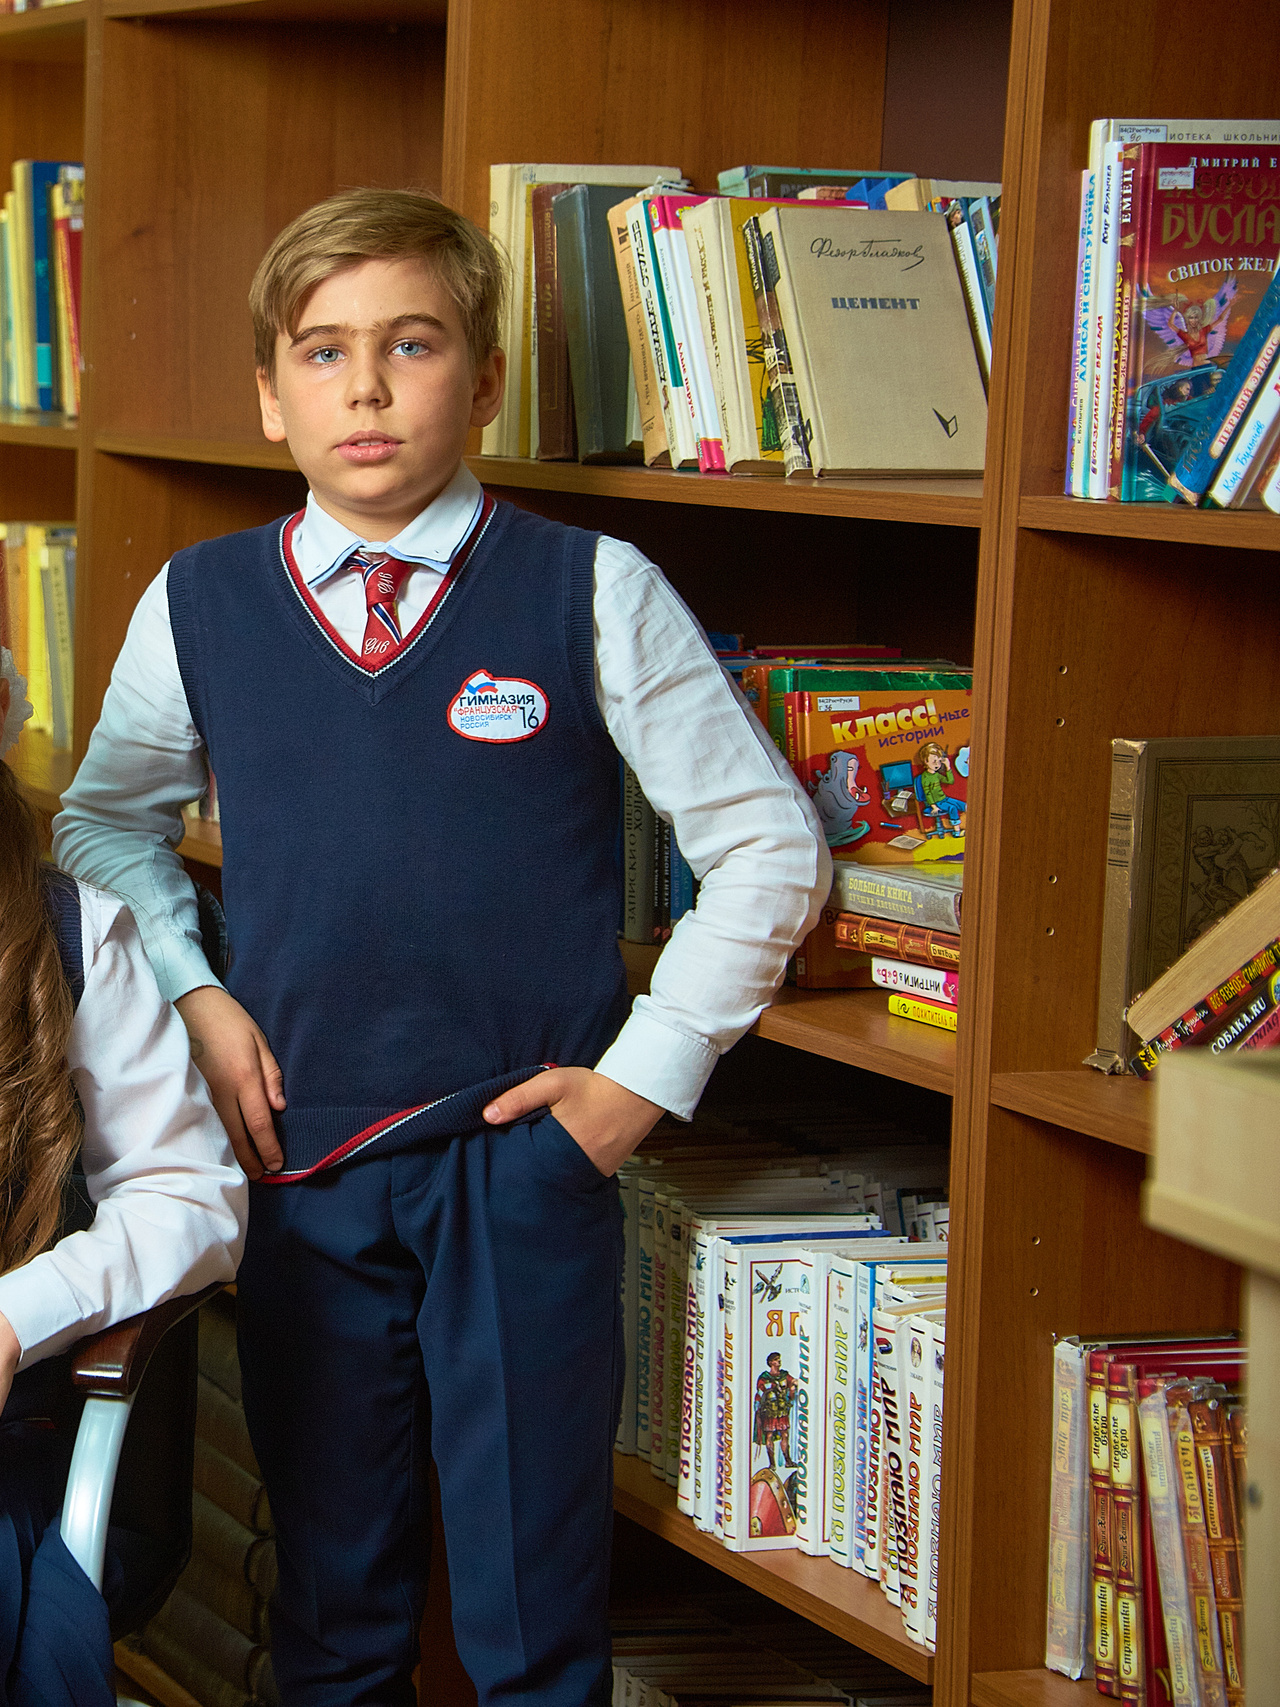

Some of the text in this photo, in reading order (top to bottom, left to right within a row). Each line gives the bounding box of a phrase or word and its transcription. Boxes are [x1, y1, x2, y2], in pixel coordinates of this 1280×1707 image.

[1189, 156, 1261, 169] ДМИТРИЙ
[1223, 133, 1280, 142] ШКОЛЬНИ
[1121, 168, 1136, 225] ЕМЕЦ
[1083, 173, 1096, 297] СНЕГУРОЧКА
[1168, 257, 1234, 283] СВИТОК
[631, 220, 667, 384] ДВЕНАДЦАТЬ СТУЛЬЕВ
[831, 297, 921, 311] ЦЕМЕНТ
[1082, 300, 1090, 314] И
[1079, 319, 1089, 382] АЛИСА
[1116, 297, 1130, 450] СВИТОК ЖЕЛАНИЙ
[677, 342, 696, 419] Алые паруса
[1218, 336, 1279, 446] ПЕРВЫЙ ЭЙДОС
[1222, 470, 1242, 493] Кир
[364, 637, 390, 654] G16
[459, 694, 535, 707] ГИМНАЗИЯ
[460, 715, 512, 723] НОВОСИБИРСК
[460, 722, 489, 730] РОССИЯ
[520, 706, 539, 729] 16
[879, 726, 944, 748] истории
[848, 877, 913, 904] БОЛЬШАЯ КНИГА
[905, 973, 941, 993] ИНТРИГИ
[1210, 949, 1277, 1010] ВСЕ ЯВНОЕ СТАНОВИТСЯ
[912, 1006, 948, 1026] ПОХИТИТЕЛЬ
[1211, 997, 1267, 1055] СОБАКА.RU
[655, 1252, 666, 1312] МИР
[765, 1309, 784, 1337] Я
[680, 1282, 696, 1479] Я ПОЗНАЮ МИР
[724, 1323, 734, 1382] МИР
[799, 1324, 810, 1385] МИР
[831, 1320, 848, 1542] Я ПОЗНАЮ МИР
[881, 1377, 901, 1445] МИР
[909, 1391, 922, 1457] МИР
[1093, 1402, 1101, 1459] Медвежье
[1100, 1416, 1108, 1447] озеро
[724, 1386, 734, 1495] ПОЗНАЮ
[797, 1388, 809, 1498] ПОЗНАЮ
[867, 1408, 880, 1522] ПОЗНАЮ
[1112, 1416, 1120, 1473] Медвежье
[1120, 1428, 1129, 1459] озеро
[854, 1378, 868, 1563] Я ПОЗНАЮ МИР
[1202, 1448, 1219, 1536] Длинные тени
[724, 1501, 732, 1522] Я
[797, 1504, 807, 1525] Я
[866, 1529, 876, 1550] Я
[888, 1452, 910, 1576] ПОЗНАЮ
[907, 1460, 921, 1581] ПОЗНАЮ
[906, 1586, 918, 1609] Я
[1098, 1585, 1109, 1658] Странники
[1122, 1601, 1133, 1676] Странники
[1169, 1618, 1185, 1695] Странники
